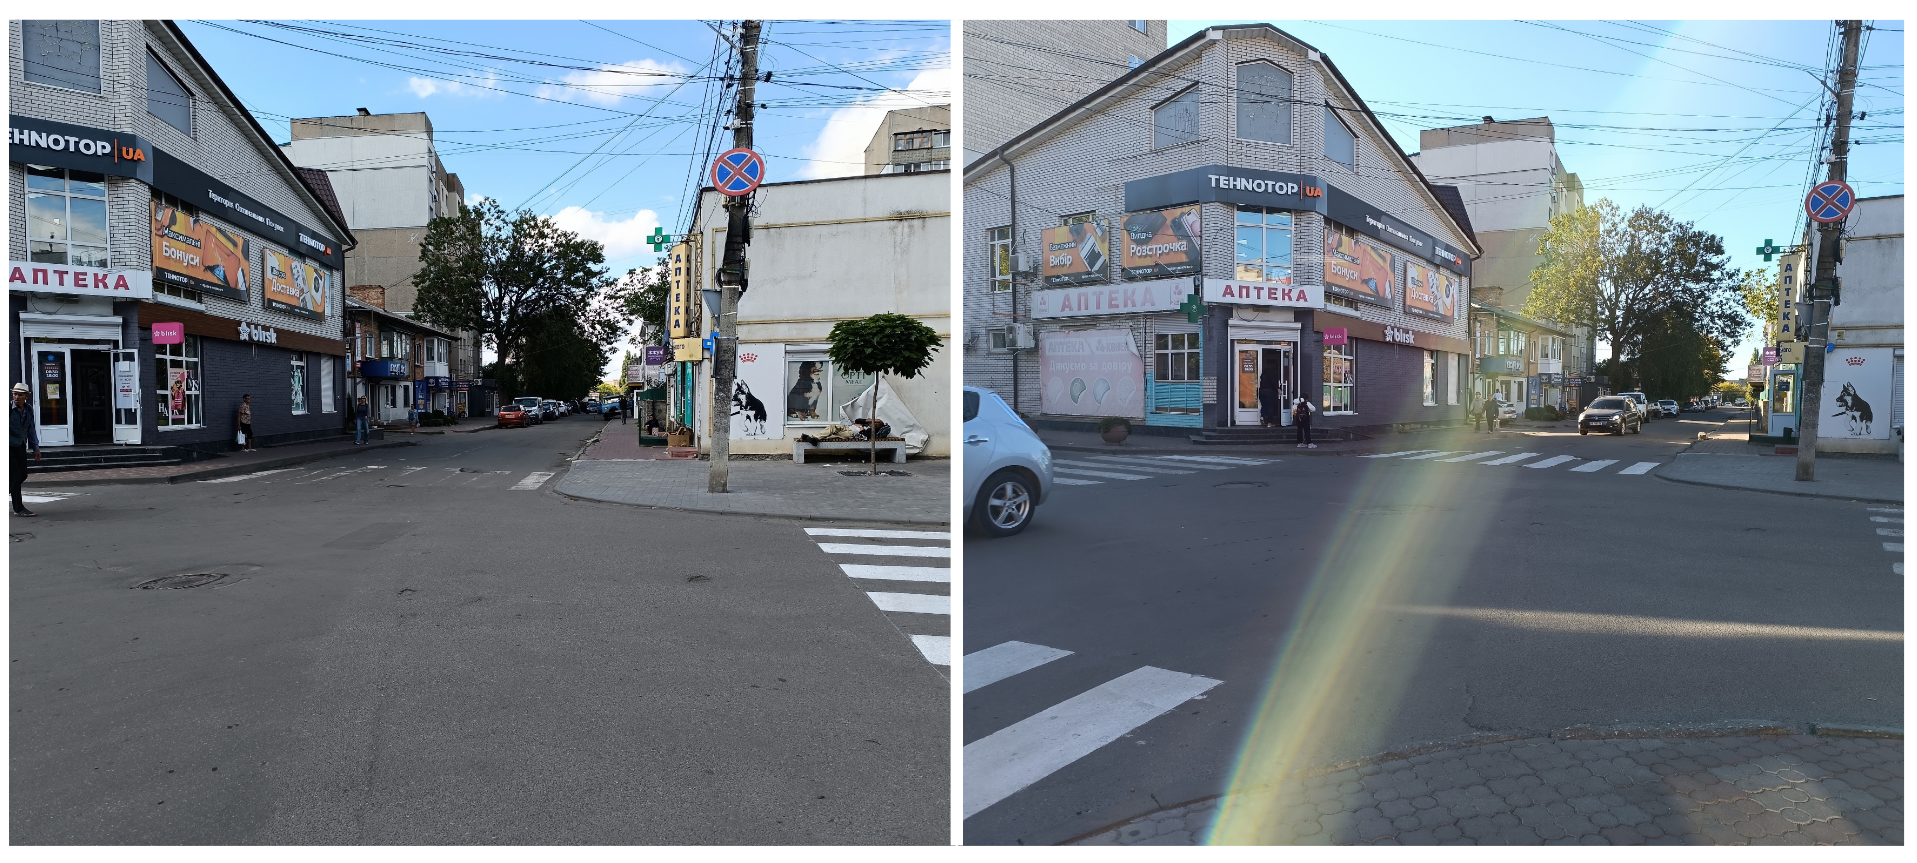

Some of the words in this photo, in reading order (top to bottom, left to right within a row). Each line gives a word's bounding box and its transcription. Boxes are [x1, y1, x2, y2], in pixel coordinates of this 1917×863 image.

[121, 146, 146, 162] UA
[1208, 174, 1299, 195] TEHNOTOP
[1305, 186, 1323, 198] UA
[163, 241, 200, 266] Бонуси
[1130, 241, 1188, 258] Розстрочка
[1050, 253, 1072, 268] Вибір
[1331, 260, 1359, 280] Бонуси
[9, 266, 130, 290] АПТЕКА
[674, 253, 682, 329] АПТЕКА
[1060, 287, 1156, 313] АПТЕКА
[1222, 284, 1308, 302] АПТЕКА
[1782, 263, 1793, 333] АПТЕКА
[250, 324, 277, 344] blisk
[1393, 327, 1415, 345] blisk
[1047, 340, 1086, 353] АПТЕКА
[1049, 360, 1086, 373] Дякуємо
[1089, 362, 1098, 371] за
[1101, 359, 1133, 373] довіру
